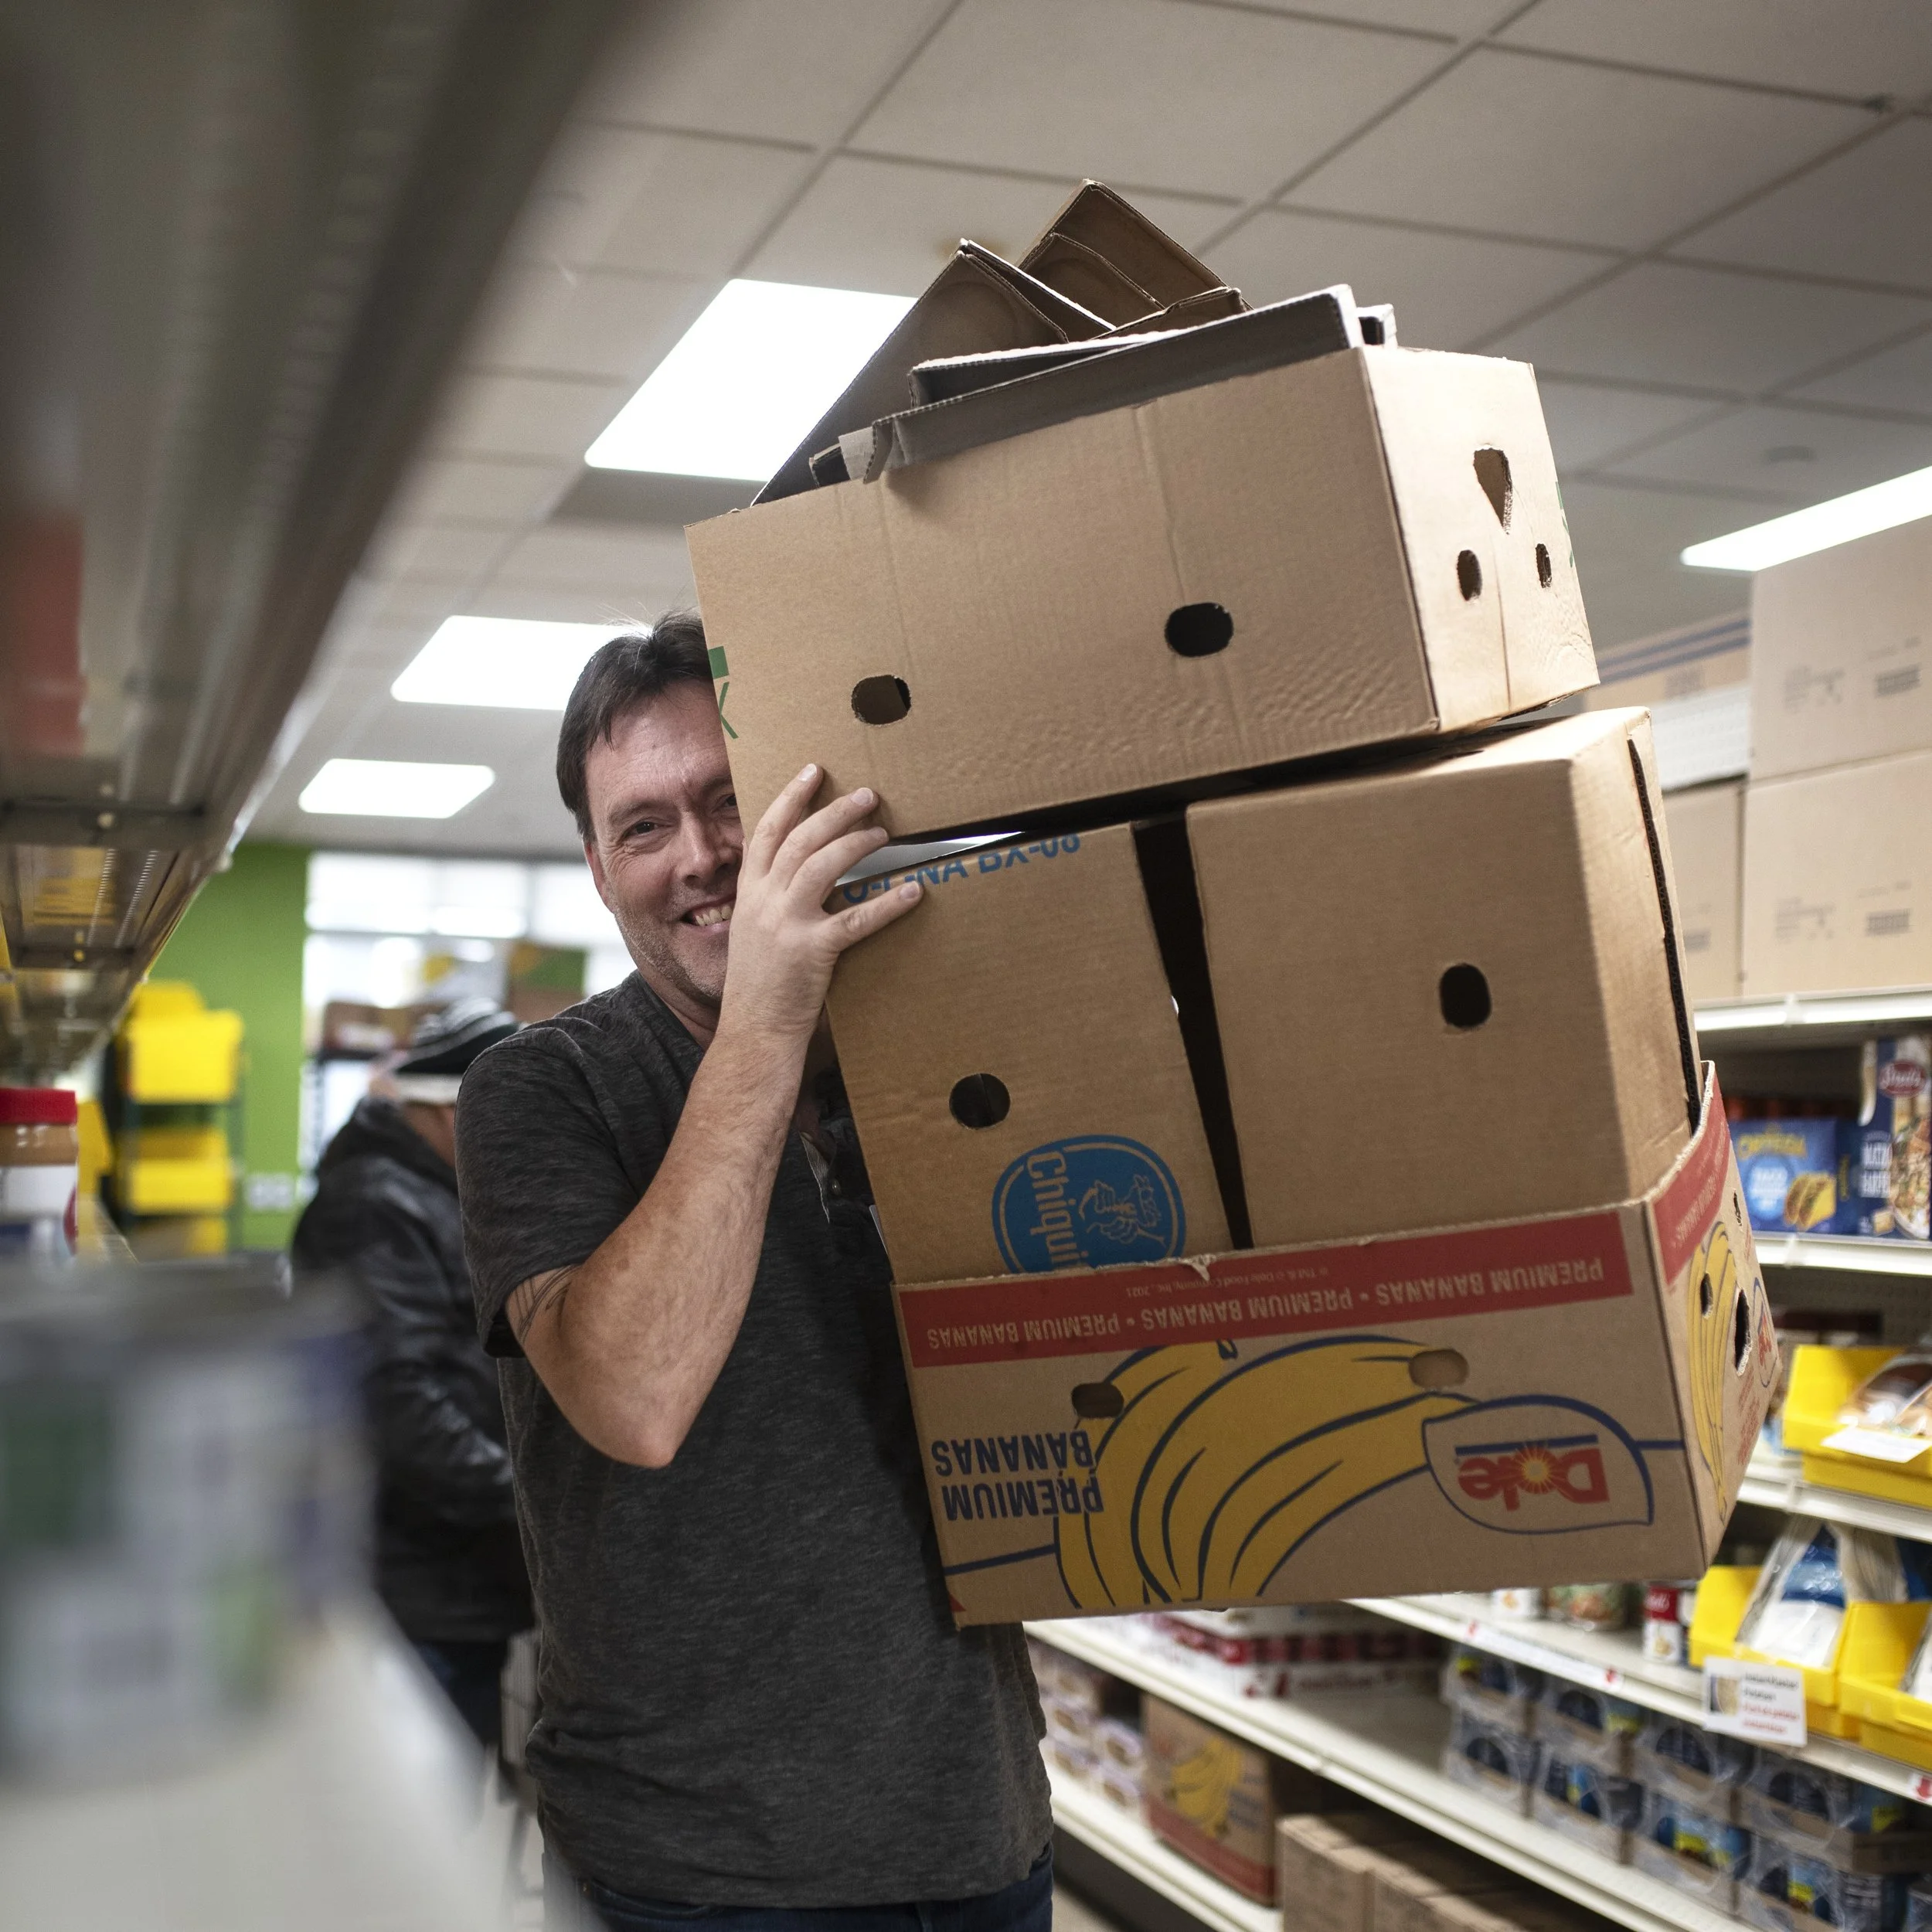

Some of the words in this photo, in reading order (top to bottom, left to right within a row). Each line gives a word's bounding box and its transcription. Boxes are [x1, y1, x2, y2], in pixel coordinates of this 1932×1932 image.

[1125, 1286, 1150, 1298] 2021
[1223, 1274, 1250, 1287] Food
[1376, 1272, 1485, 1305] BANANAS
[1489, 1258, 1604, 1293] PREMIUM
[1141, 1299, 1243, 1331] BANANAS
[1248, 1287, 1353, 1320] PREMIUM
[927, 1321, 1019, 1349] BANANAS
[1023, 1313, 1120, 1342] PREMIUM
[931, 1430, 1094, 1477] BANANAS
[1458, 1447, 1610, 1511] Dole
[940, 1477, 1104, 1521] PREMIUM
